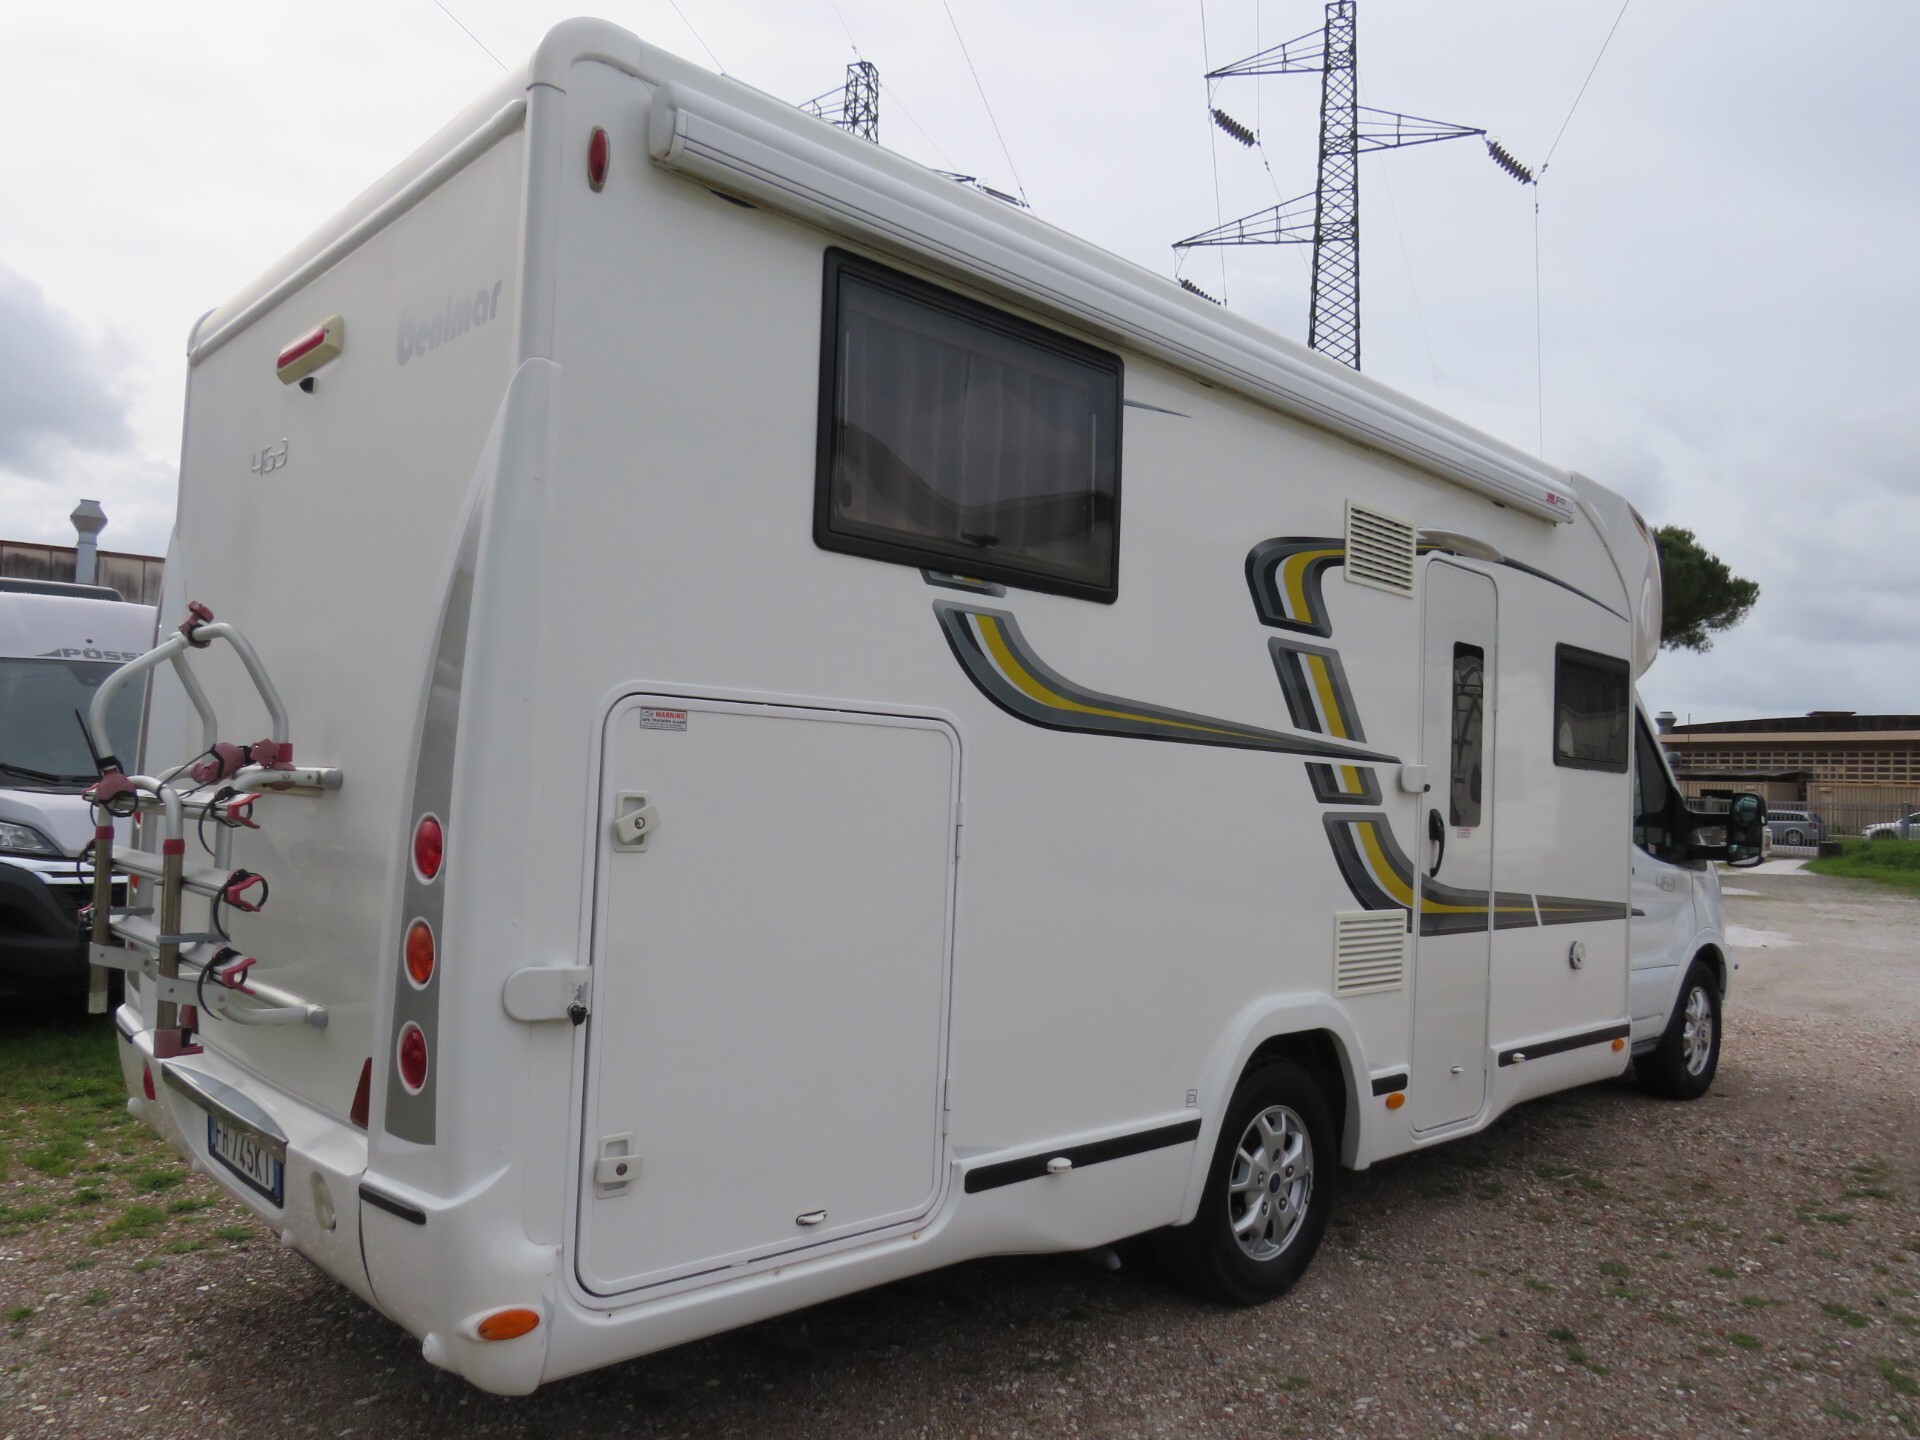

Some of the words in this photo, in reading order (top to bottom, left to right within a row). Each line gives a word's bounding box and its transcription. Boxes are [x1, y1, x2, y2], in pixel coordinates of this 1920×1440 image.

[251, 438, 288, 476] 463
[62, 648, 146, 661] PÖSS
[655, 711, 685, 719] WARNING
